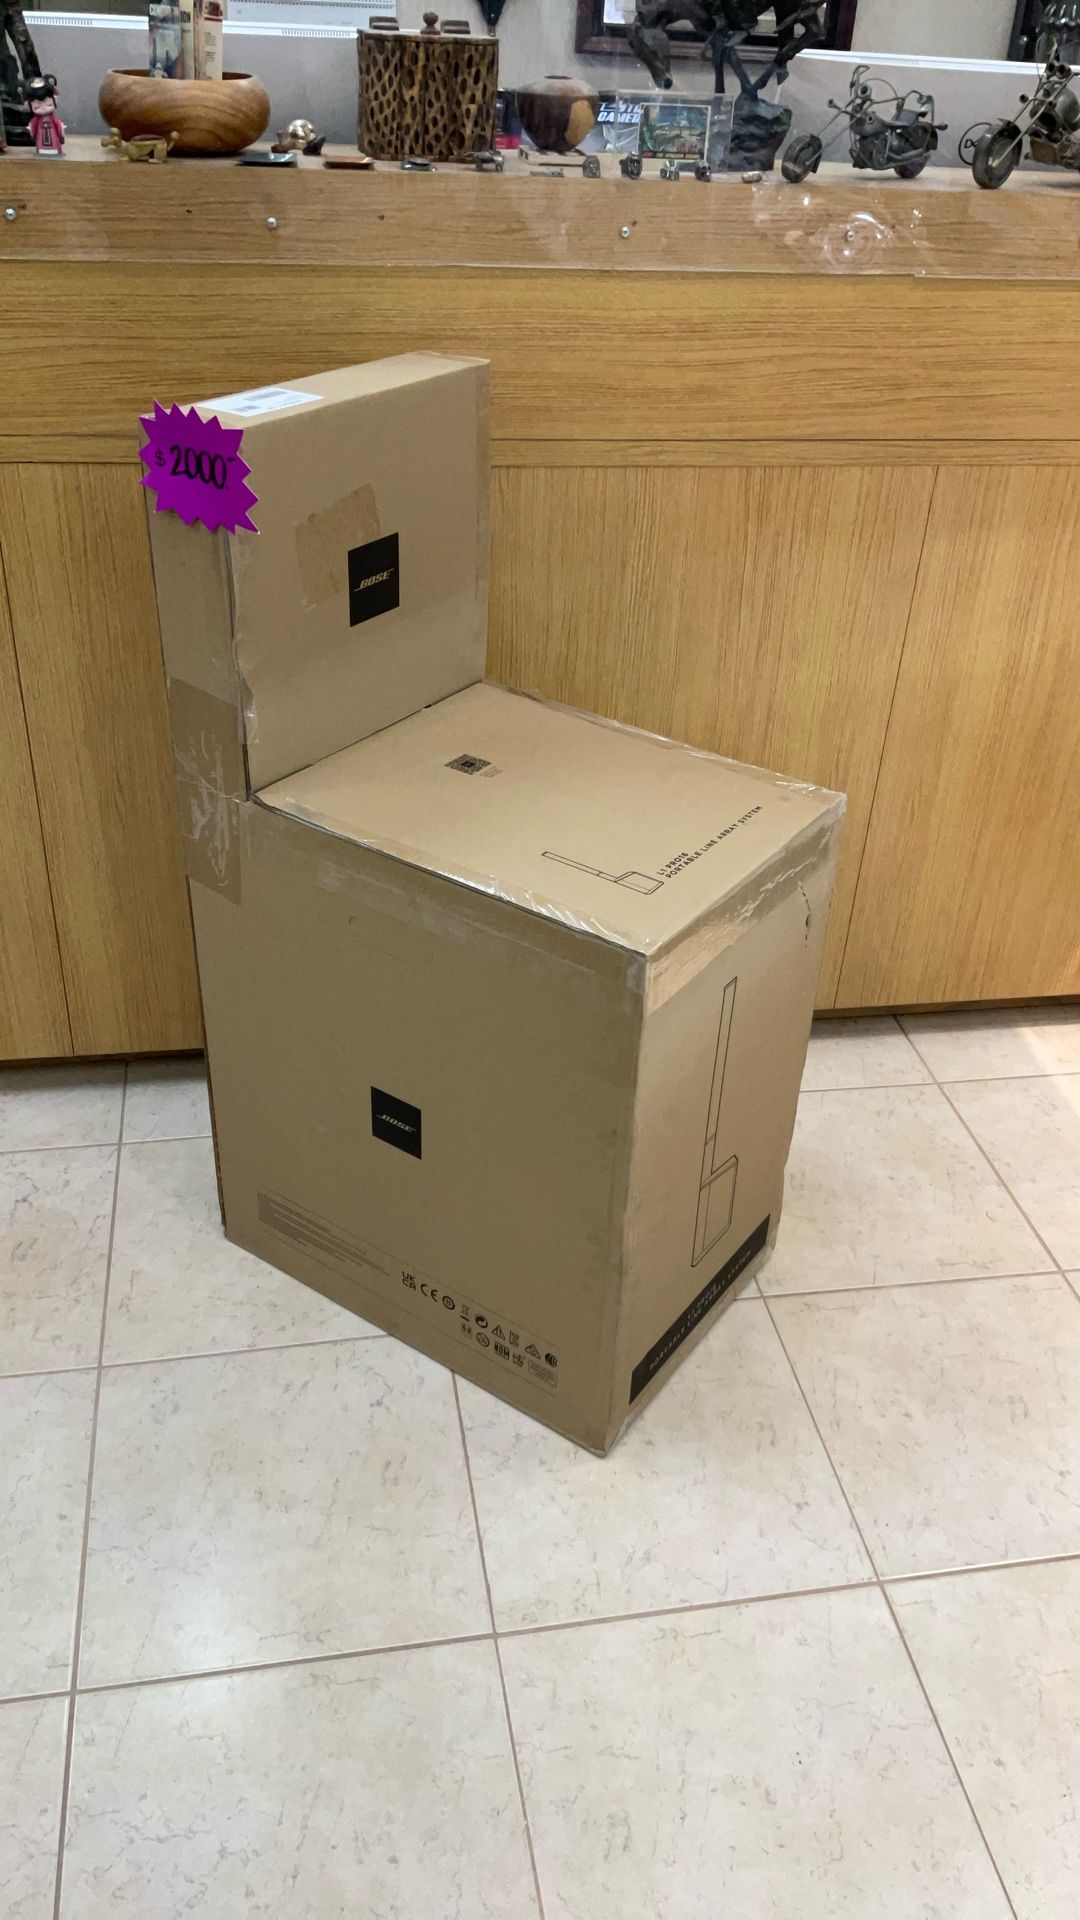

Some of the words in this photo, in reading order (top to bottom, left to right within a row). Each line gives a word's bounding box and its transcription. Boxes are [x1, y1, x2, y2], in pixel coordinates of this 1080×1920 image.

[353, 567, 395, 592] BOSE
[665, 851, 702, 879] PORTABLE
[700, 839, 718, 852] LINE
[716, 823, 738, 840] ARRAY
[737, 805, 762, 824] SYSTEM
[376, 1114, 417, 1133] BOSE
